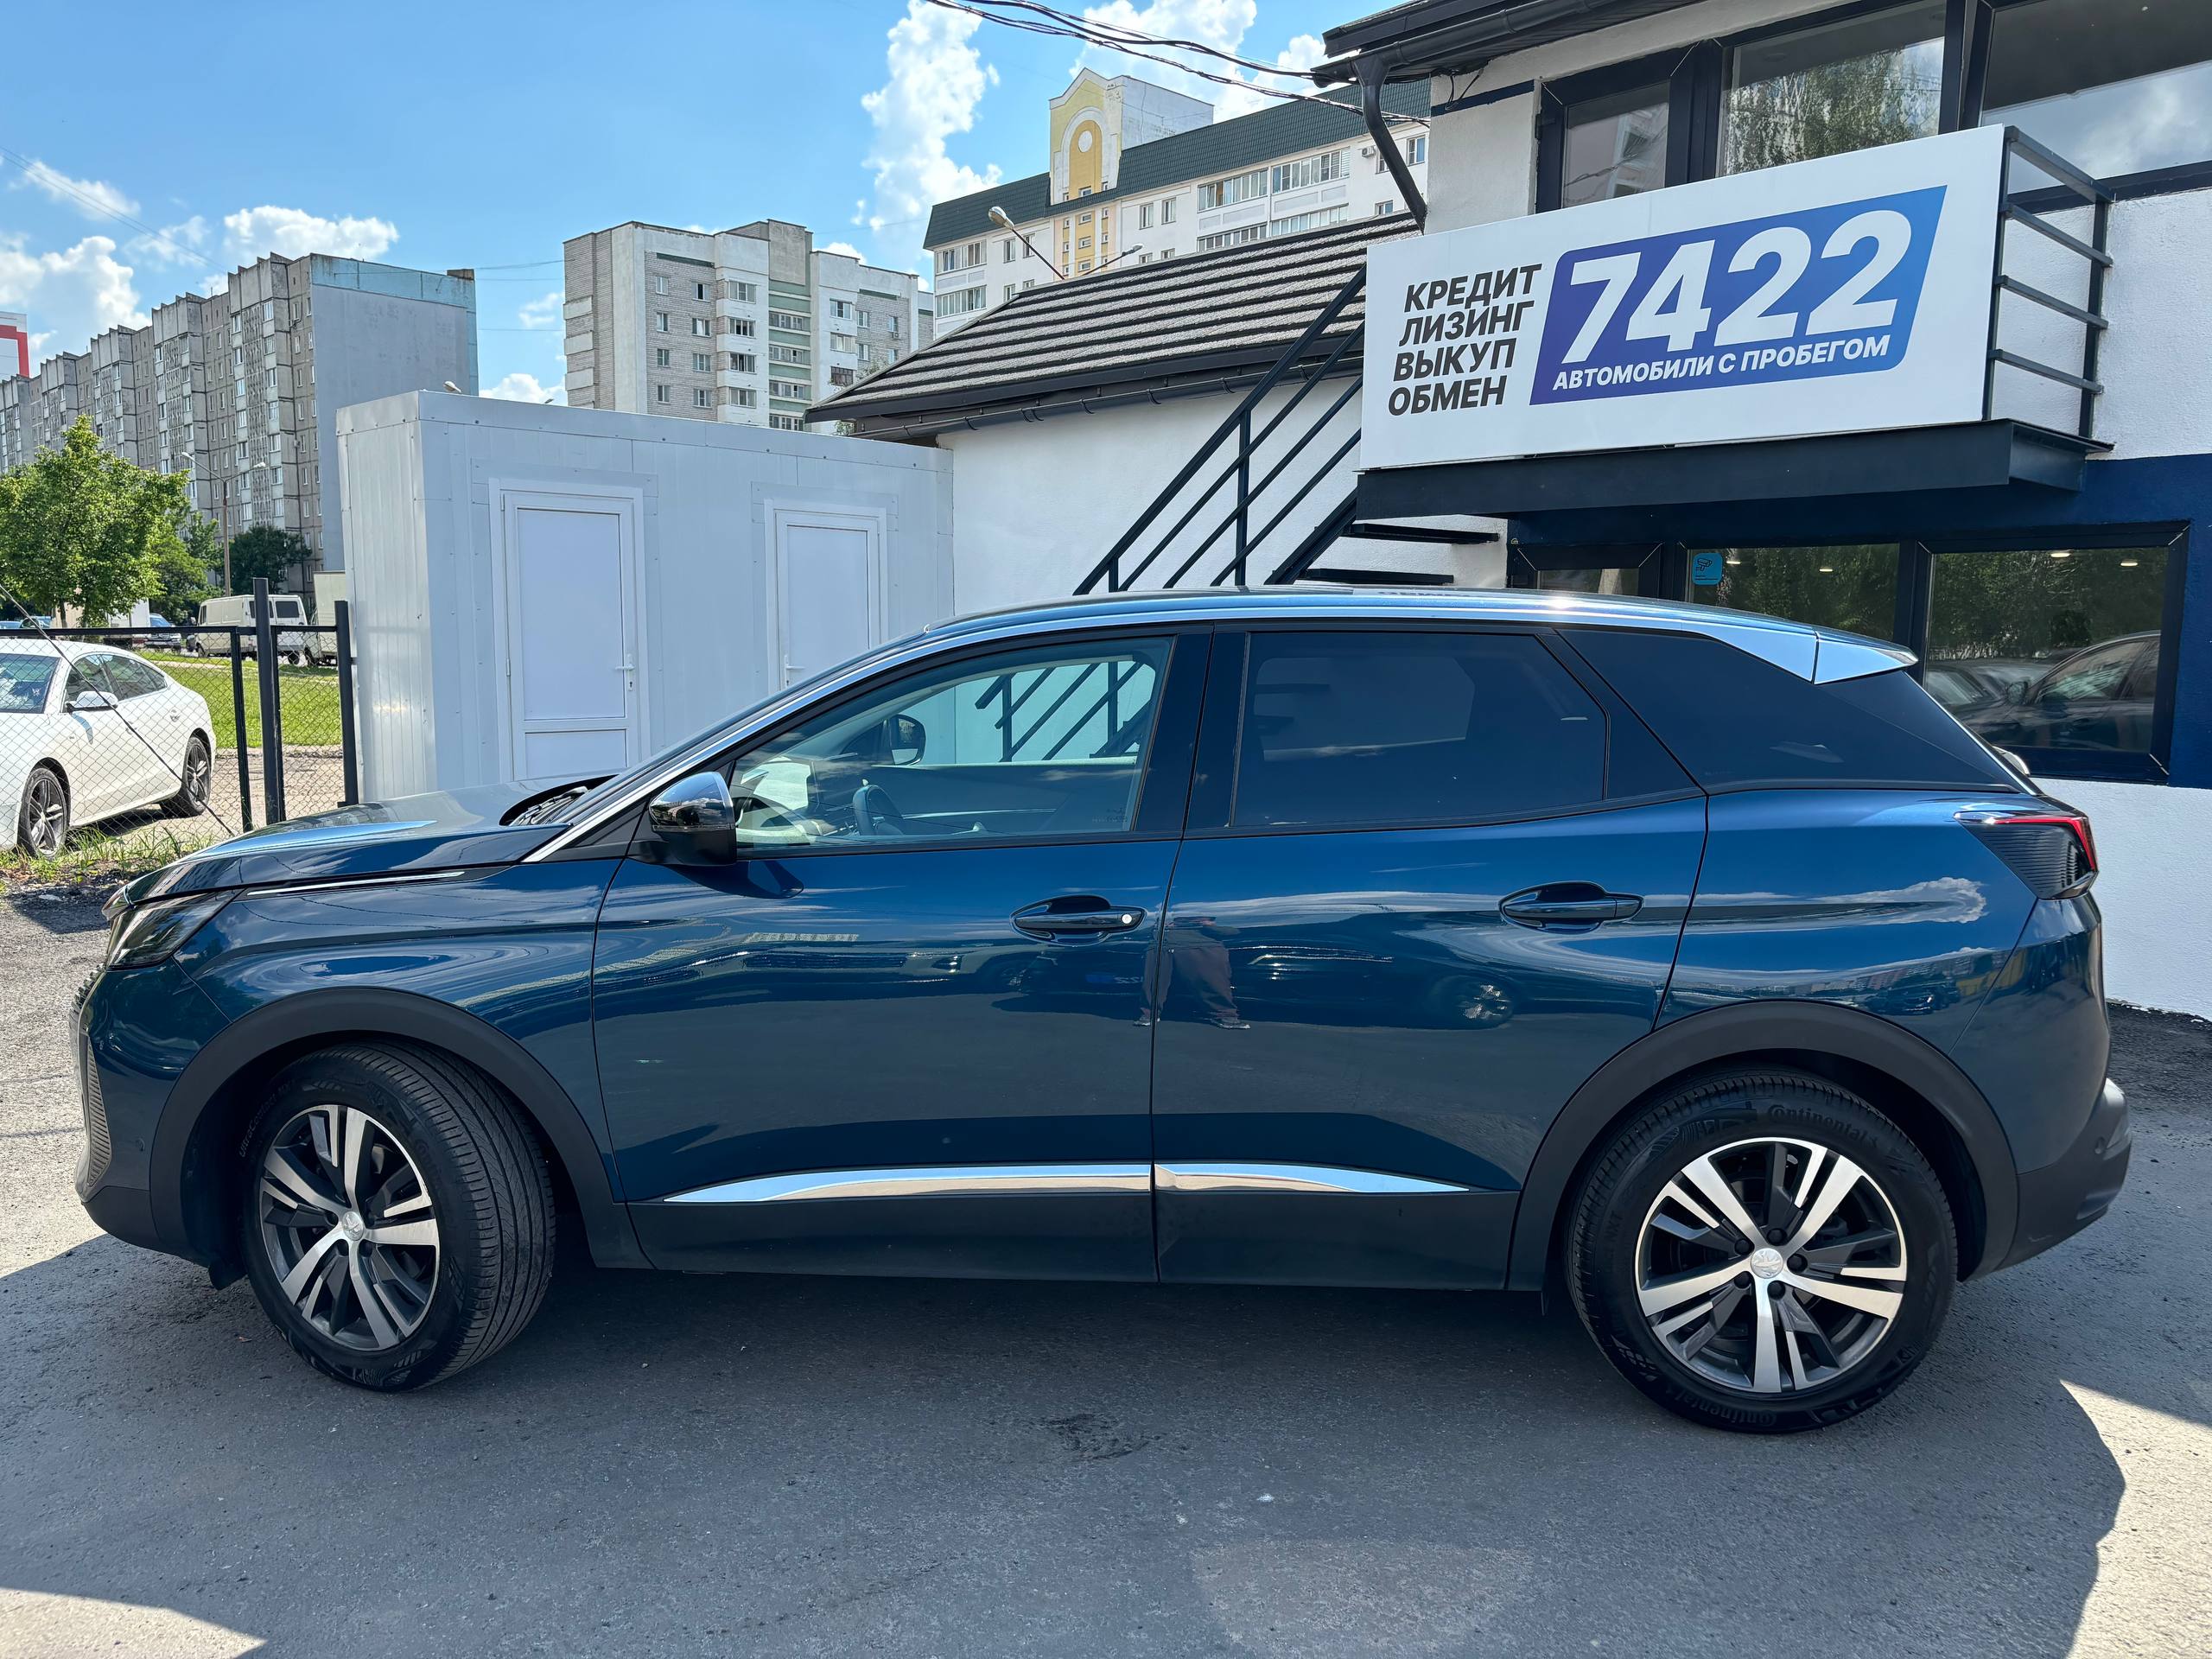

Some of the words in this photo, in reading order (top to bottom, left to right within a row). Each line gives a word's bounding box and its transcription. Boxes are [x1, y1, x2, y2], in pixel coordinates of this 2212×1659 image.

[1404, 264, 1543, 313] КРЕДИТ
[1562, 210, 1912, 365] 7422
[1399, 301, 1535, 347] ЛИЗИНГ
[1393, 338, 1516, 382] ВЫКУП
[1552, 355, 1714, 391] АВТОМОБИЛИ
[1718, 352, 1736, 374] С
[1740, 334, 1891, 372] ПРОБЕГОМ
[1388, 376, 1507, 416] ОБМЕН
[1767, 1104, 1867, 1143] Continental
